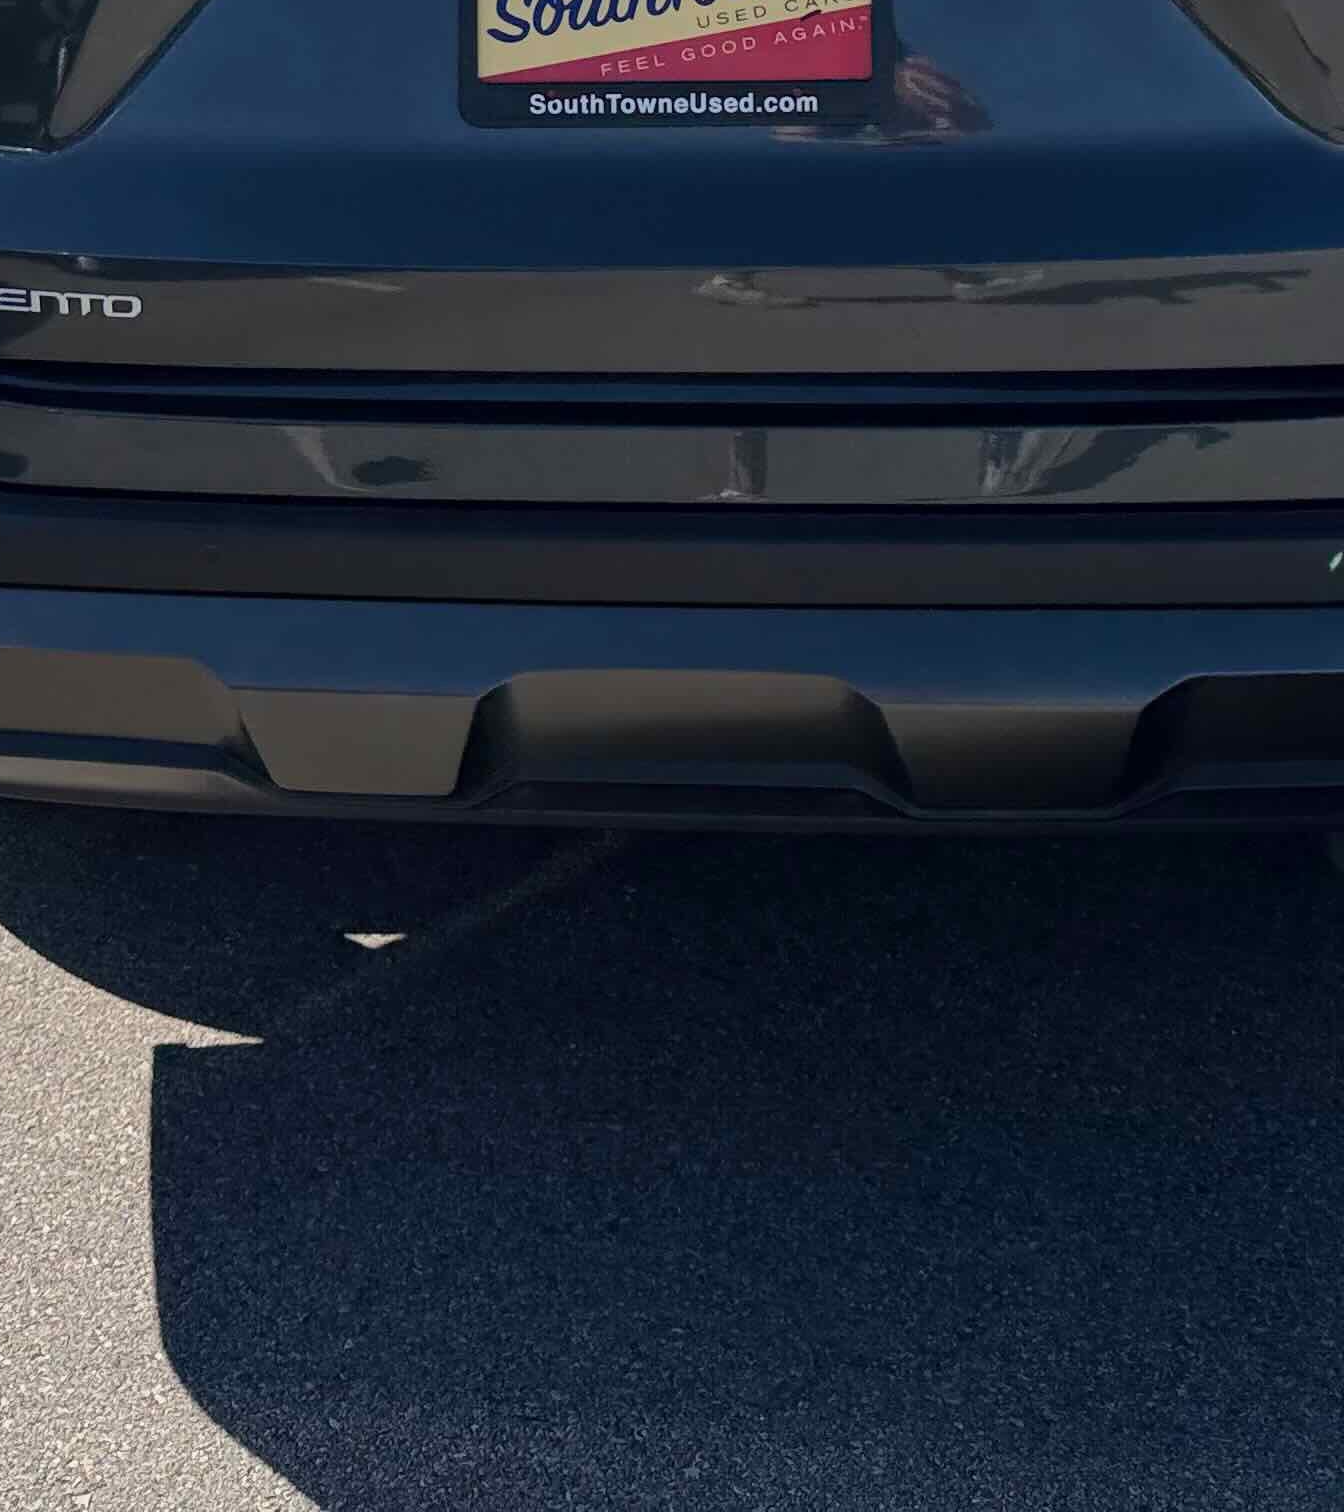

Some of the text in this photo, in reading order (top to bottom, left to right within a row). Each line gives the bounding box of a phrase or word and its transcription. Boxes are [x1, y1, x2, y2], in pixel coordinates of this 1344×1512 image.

[696, 4, 767, 29] USED
[599, 54, 665, 77] FEEL
[680, 36, 757, 62] GOOD
[529, 92, 819, 115] SouthTowneUsed.com
